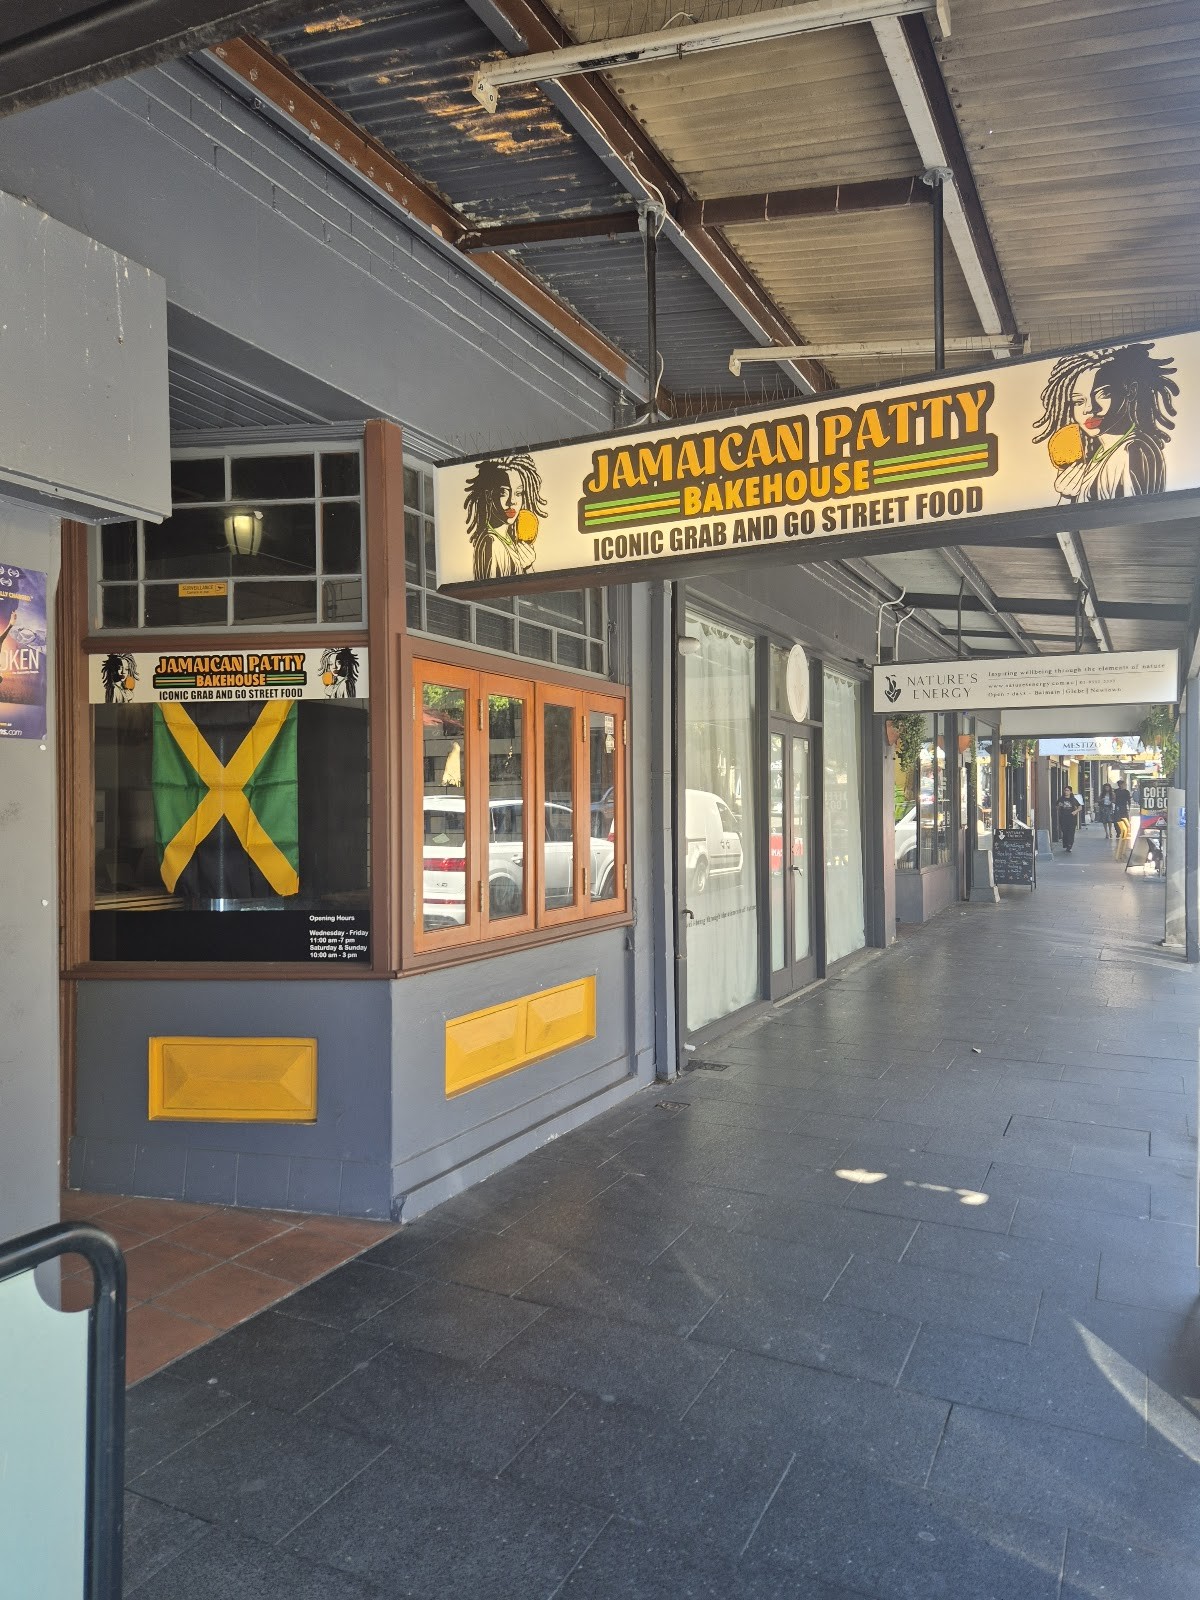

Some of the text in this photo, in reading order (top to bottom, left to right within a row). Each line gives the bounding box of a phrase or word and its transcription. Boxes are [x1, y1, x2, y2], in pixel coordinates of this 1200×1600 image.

[587, 389, 987, 493] JAMAICAN PATTY
[684, 460, 870, 517] BAKEHOUSE
[593, 486, 983, 562] ICONIC GRAB AND GO STREET FOOD
[157, 654, 304, 673] JAMAICAN PATTY
[196, 673, 266, 687] BAKEHOUSE
[907, 673, 978, 686] NATURE'S
[159, 688, 303, 700] ICONIC GRAB AND GO STREET FOOD
[913, 687, 971, 699] ENERGY
[1143, 787, 1167, 798] COFF
[1143, 798, 1155, 808] TO
